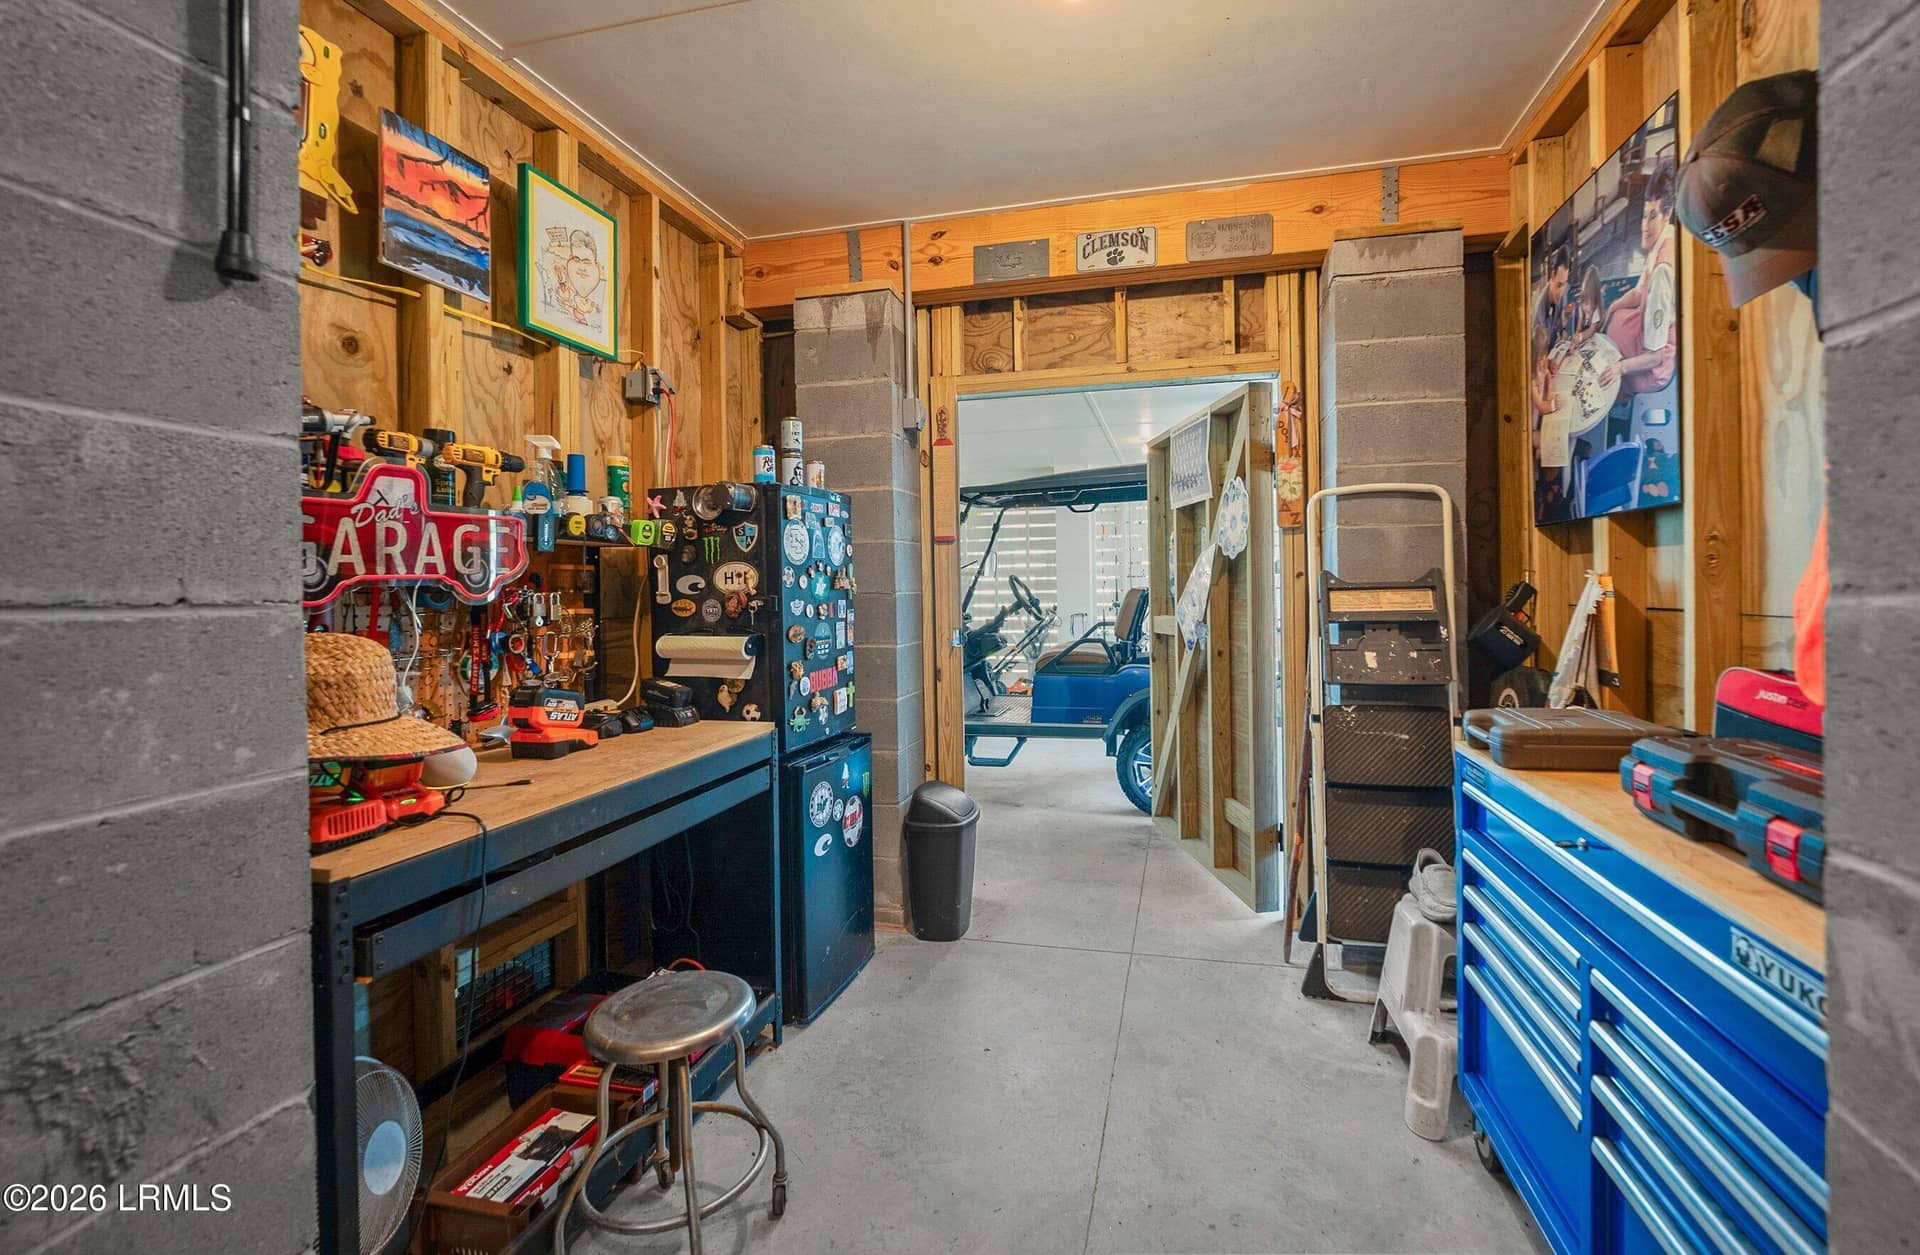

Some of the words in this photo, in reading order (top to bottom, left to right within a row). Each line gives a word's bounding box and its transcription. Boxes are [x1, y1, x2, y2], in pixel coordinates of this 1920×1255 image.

[1082, 231, 1150, 259] CLEMSON
[351, 494, 421, 528] Dad's
[738, 527, 744, 536] S
[809, 666, 839, 693] BUBBA
